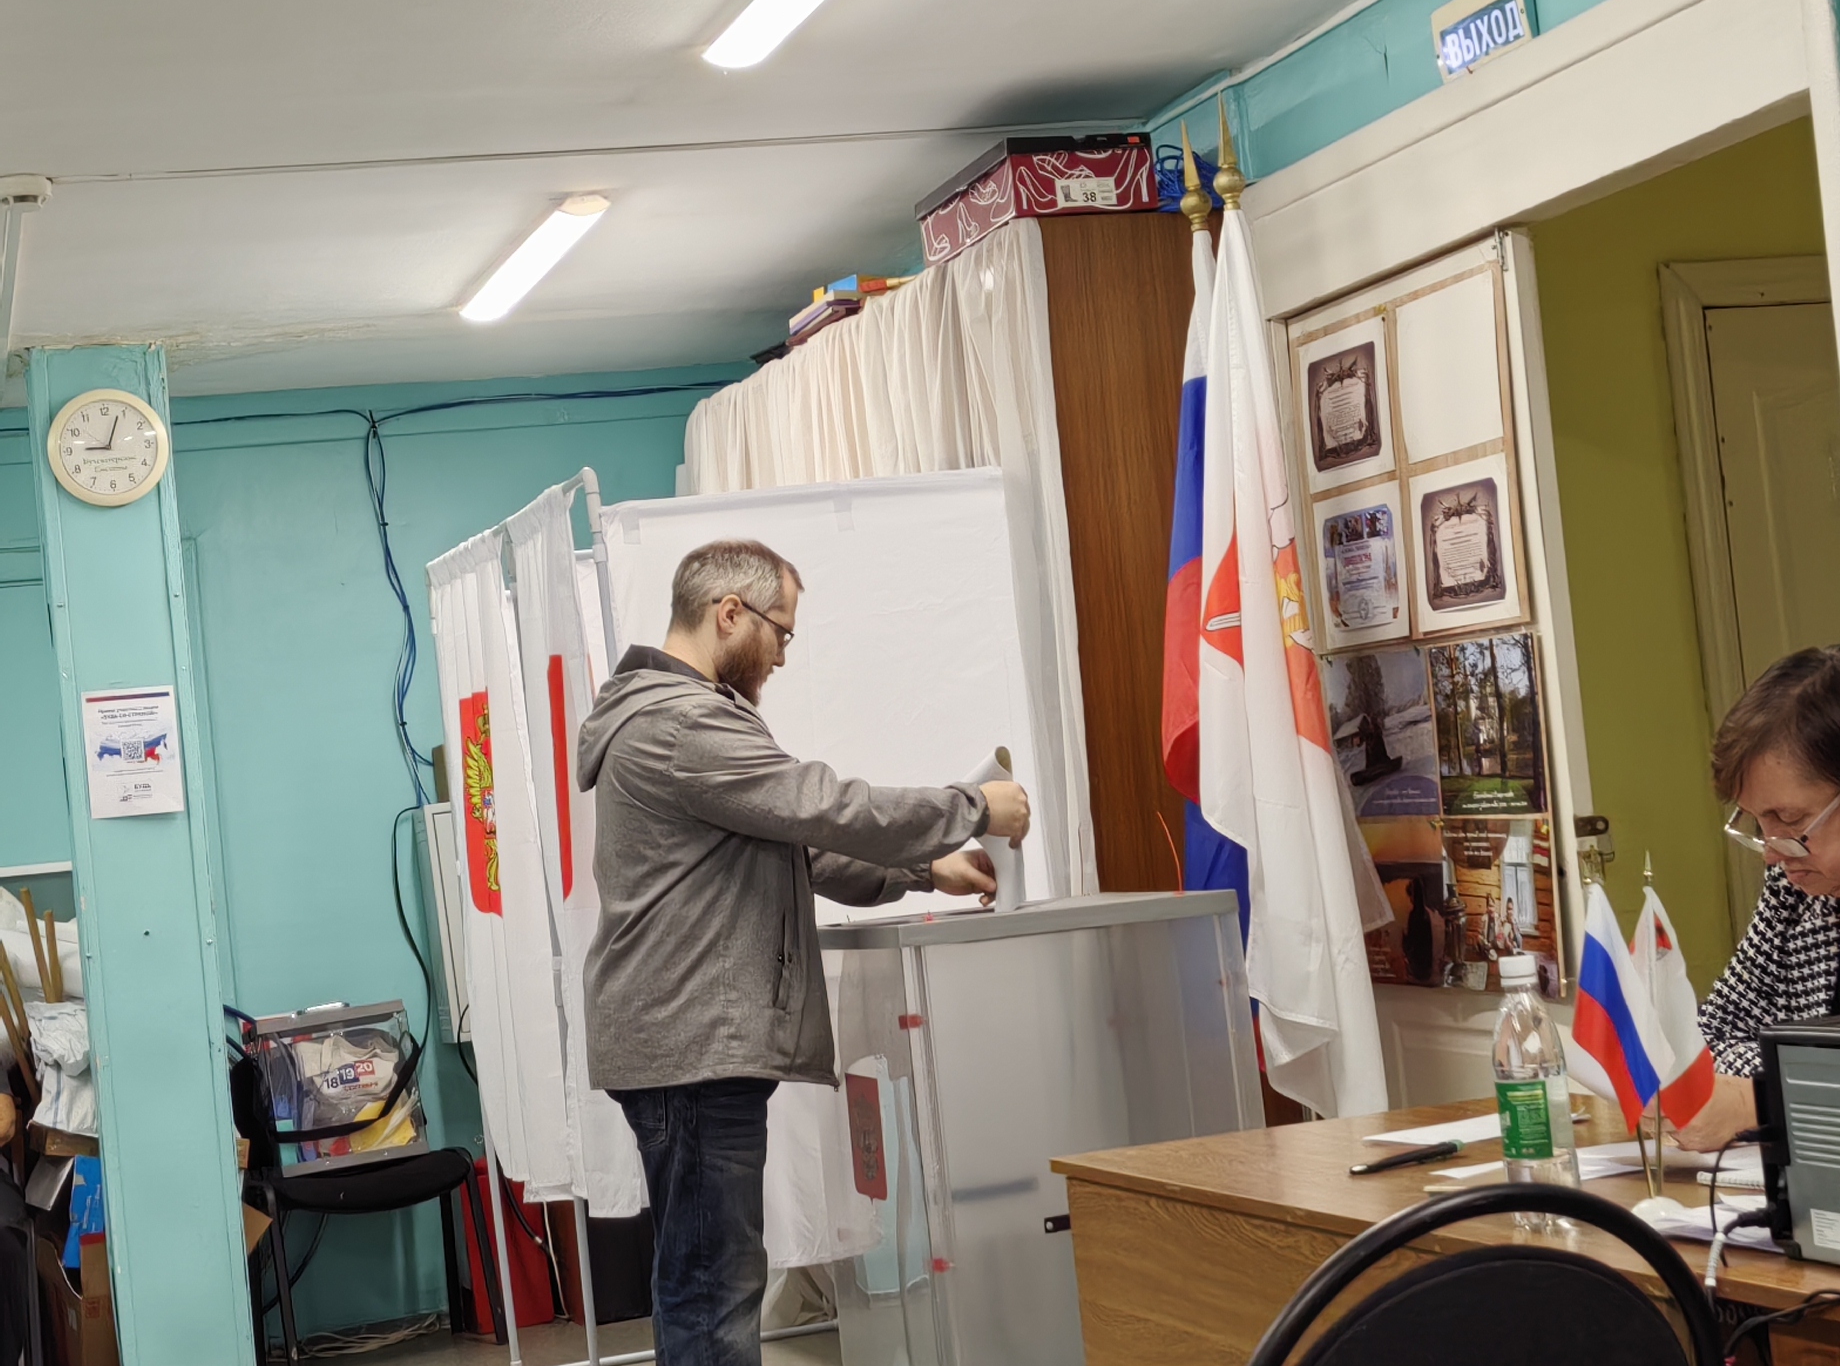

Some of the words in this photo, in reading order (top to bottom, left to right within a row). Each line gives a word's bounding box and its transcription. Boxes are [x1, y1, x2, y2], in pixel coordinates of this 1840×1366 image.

[1444, 0, 1524, 69] ВЫХОД
[1082, 191, 1097, 203] 38
[100, 406, 109, 416] 12
[121, 408, 127, 419] 1
[82, 413, 90, 423] 11
[136, 420, 144, 431] 2
[70, 427, 81, 437] 10
[144, 439, 151, 449] 3
[66, 446, 73, 456] 9
[141, 458, 148, 467] 4
[74, 464, 81, 474] 8
[89, 476, 97, 486] 7
[128, 473, 136, 482] 5
[110, 479, 117, 489] 6
[325, 1077, 339, 1089] 18
[341, 1068, 355, 1081] 19
[355, 1061, 373, 1073] 20
